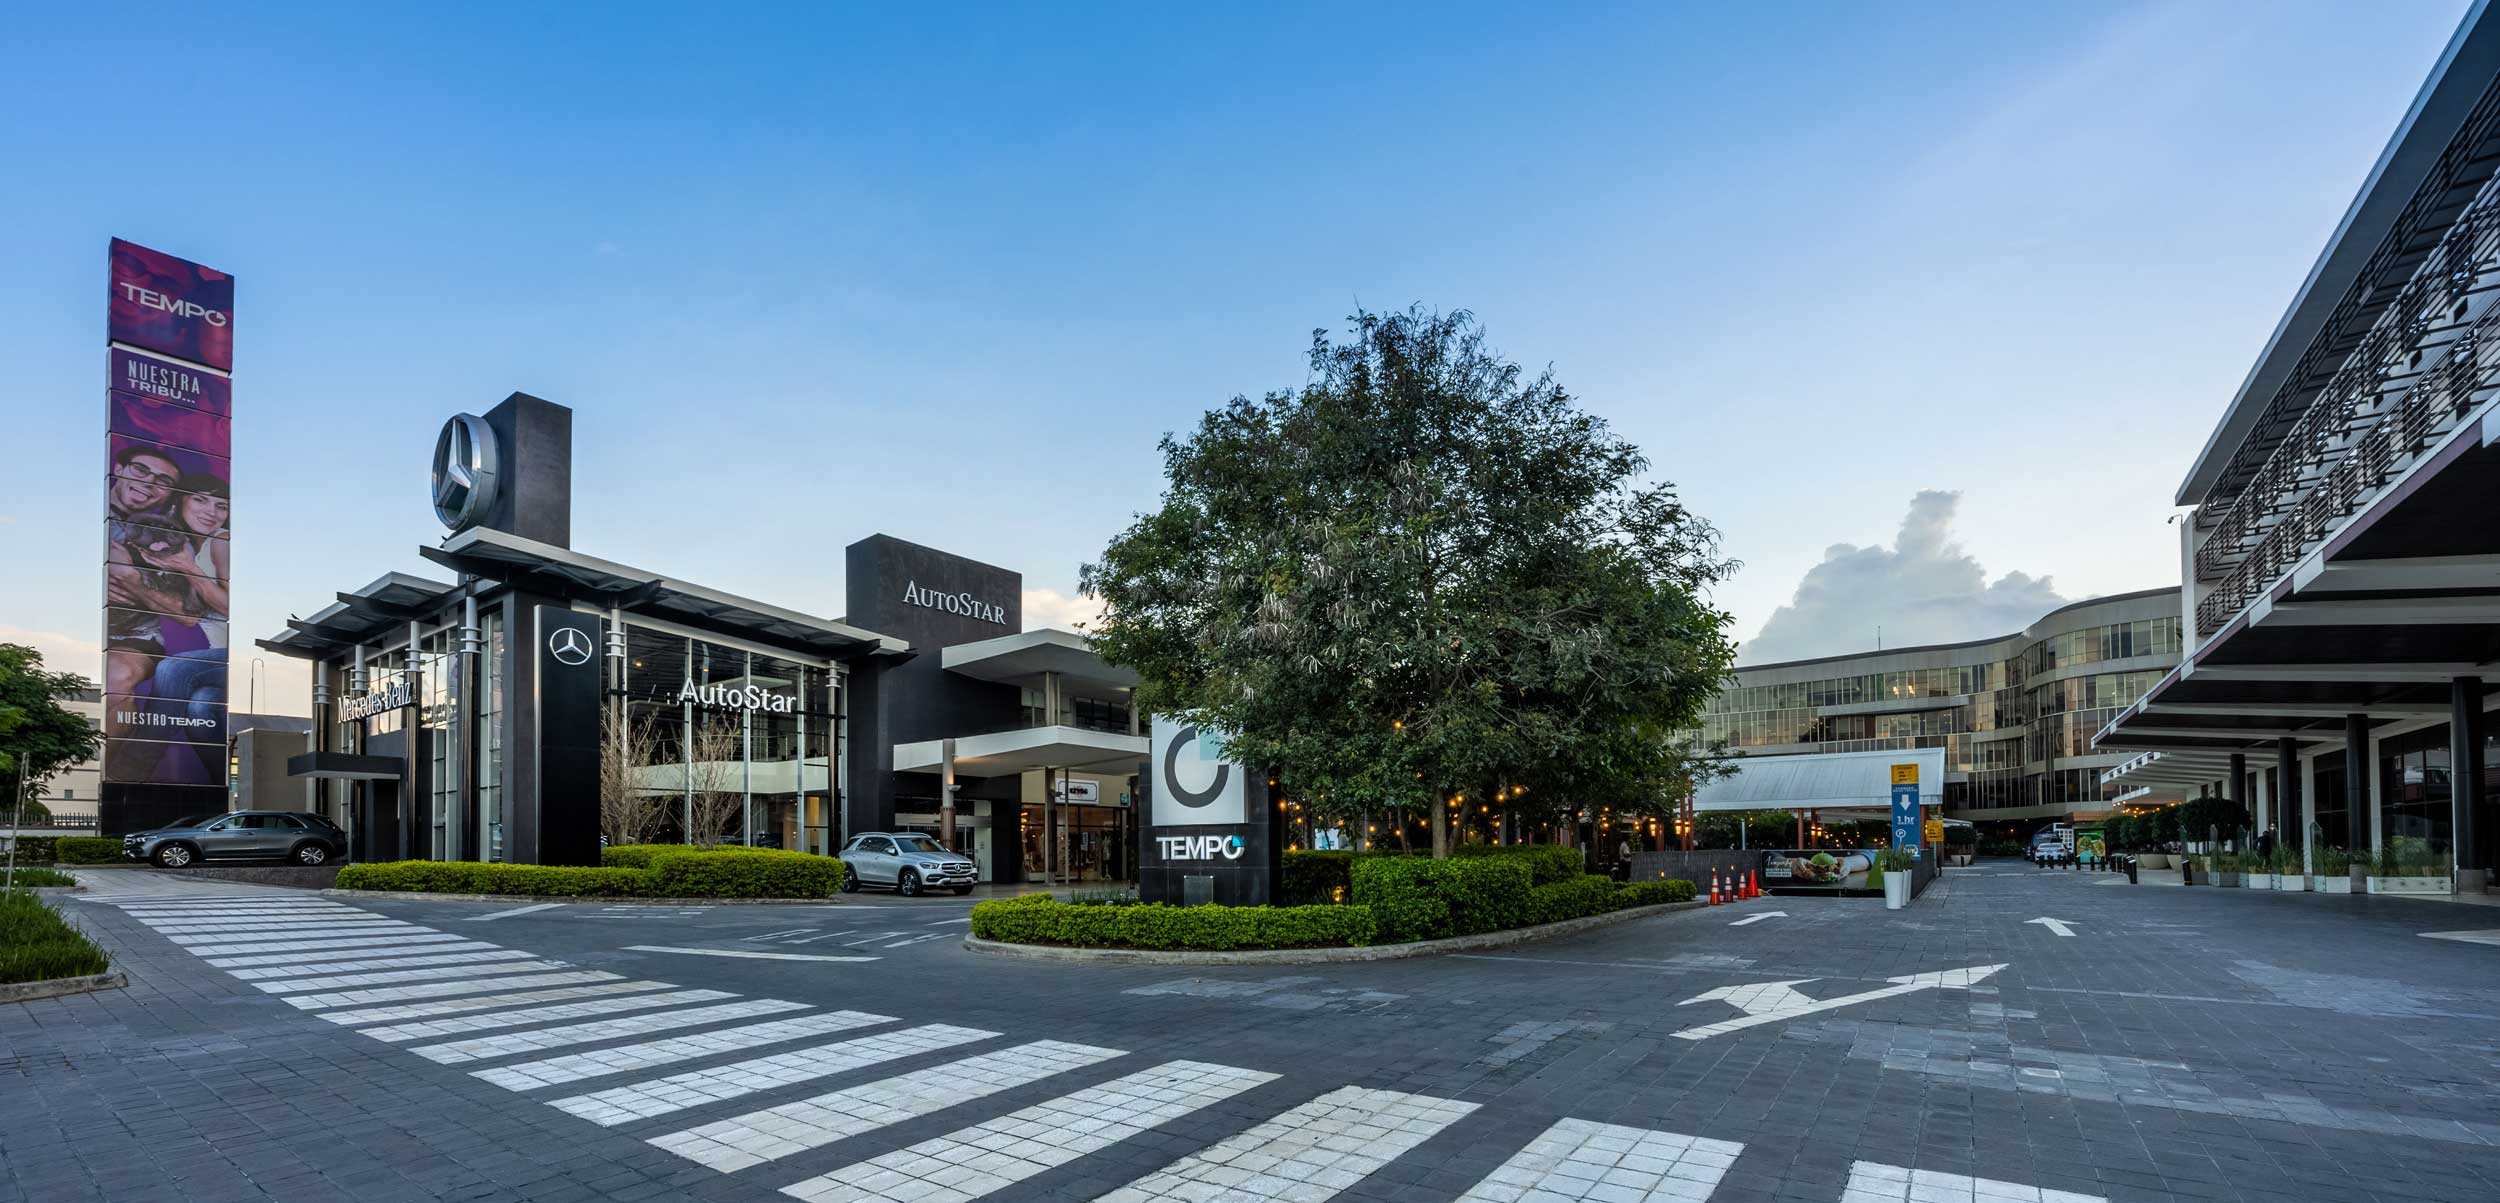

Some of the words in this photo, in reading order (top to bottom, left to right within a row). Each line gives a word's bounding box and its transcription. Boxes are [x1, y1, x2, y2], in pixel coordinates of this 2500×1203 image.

[120, 282, 227, 327] TEMPO
[127, 378, 196, 403] TRIBU...
[128, 359, 200, 394] NUESTRA
[337, 682, 412, 723] Mercedes-Benz
[680, 677, 796, 713] AutoStar
[1155, 835, 1244, 860] TEMPO
